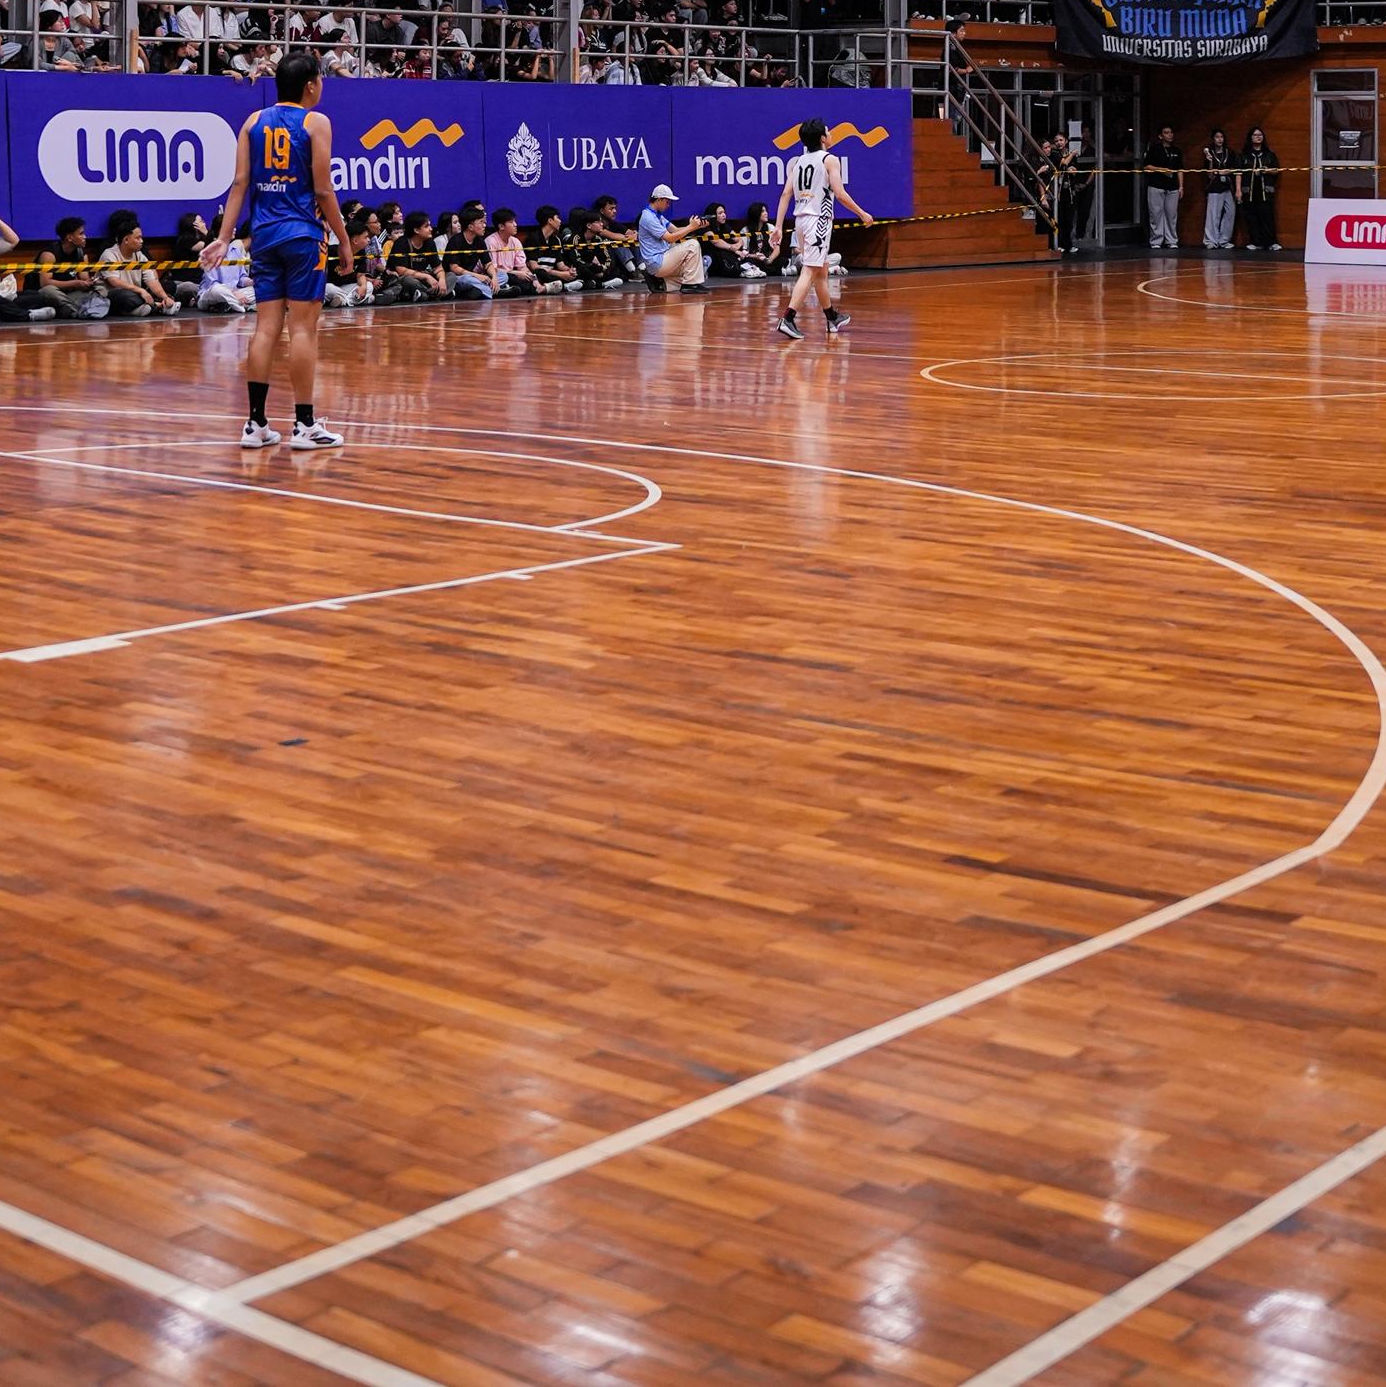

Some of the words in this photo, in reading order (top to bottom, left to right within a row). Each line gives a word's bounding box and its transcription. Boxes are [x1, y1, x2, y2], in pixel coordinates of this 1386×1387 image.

[1119, 5, 1173, 38] BIRU
[1101, 34, 1193, 59] UNIVERSITAS
[1196, 34, 1269, 59] SURABAYA
[76, 127, 205, 183] LIMA
[263, 125, 291, 170] 19
[556, 137, 654, 171] UBAYA
[329, 144, 431, 192] andiri
[798, 163, 815, 192] 10
